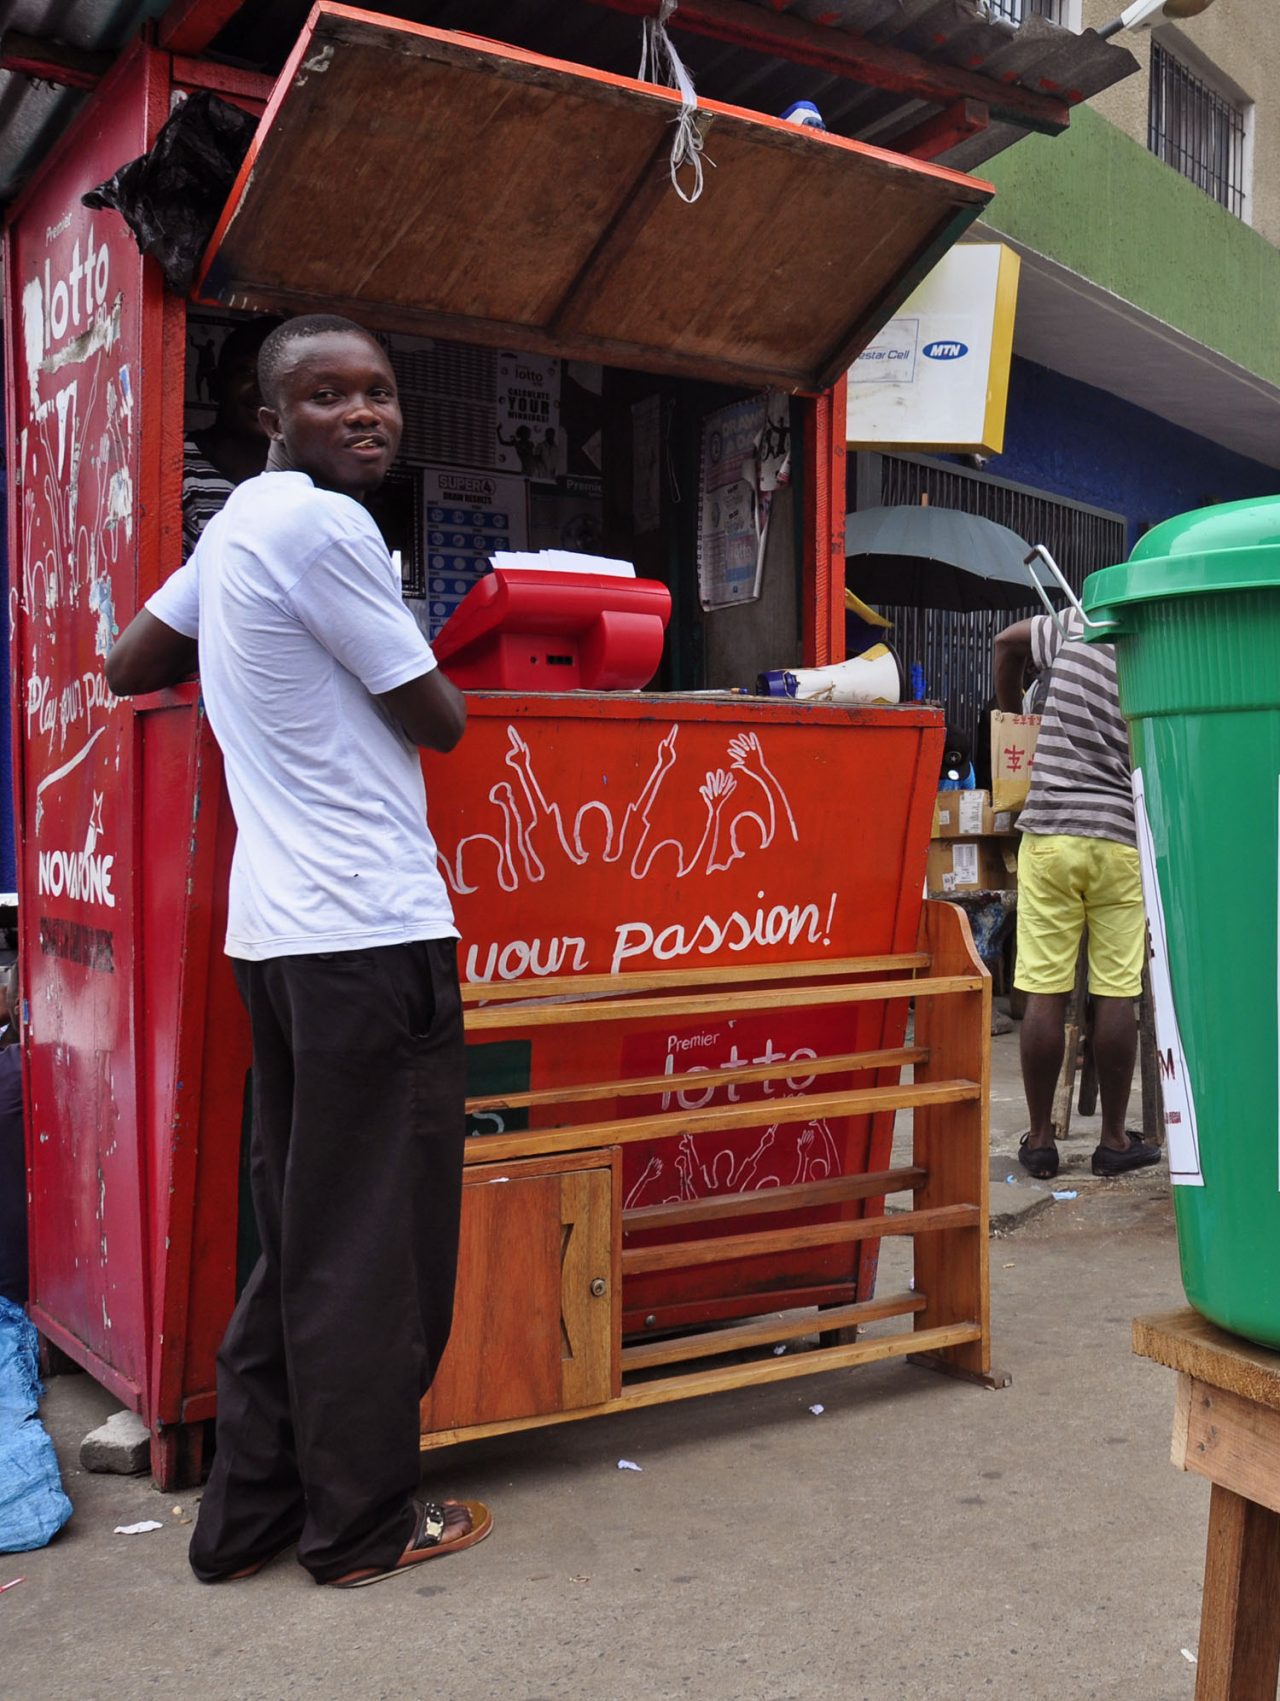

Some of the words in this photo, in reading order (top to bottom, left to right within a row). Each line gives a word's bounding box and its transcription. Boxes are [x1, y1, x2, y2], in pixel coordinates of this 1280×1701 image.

[44, 222, 109, 348] lotto
[858, 351, 887, 360] estar
[930, 344, 961, 357] MTN
[508, 396, 550, 415] YOUR
[667, 1031, 721, 1053] Premier
